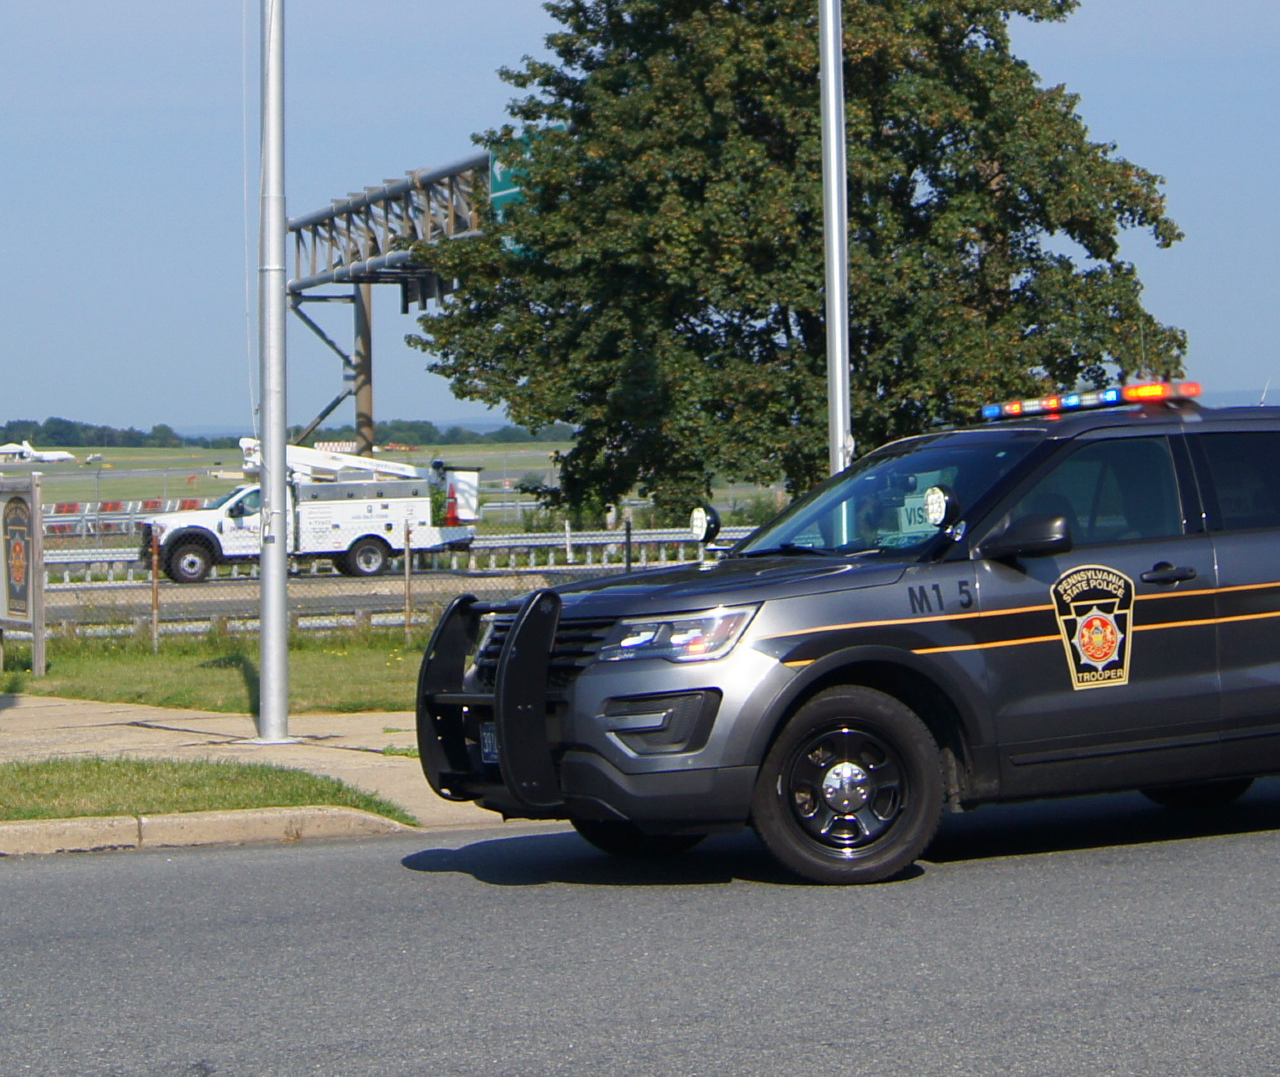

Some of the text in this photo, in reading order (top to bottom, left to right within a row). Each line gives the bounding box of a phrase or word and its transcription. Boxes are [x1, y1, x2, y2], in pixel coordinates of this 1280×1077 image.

[1058, 569, 1125, 595] PENNSYLVANIA
[1062, 579, 1125, 603] STATE POLICE
[1077, 668, 1124, 682] TROOPER
